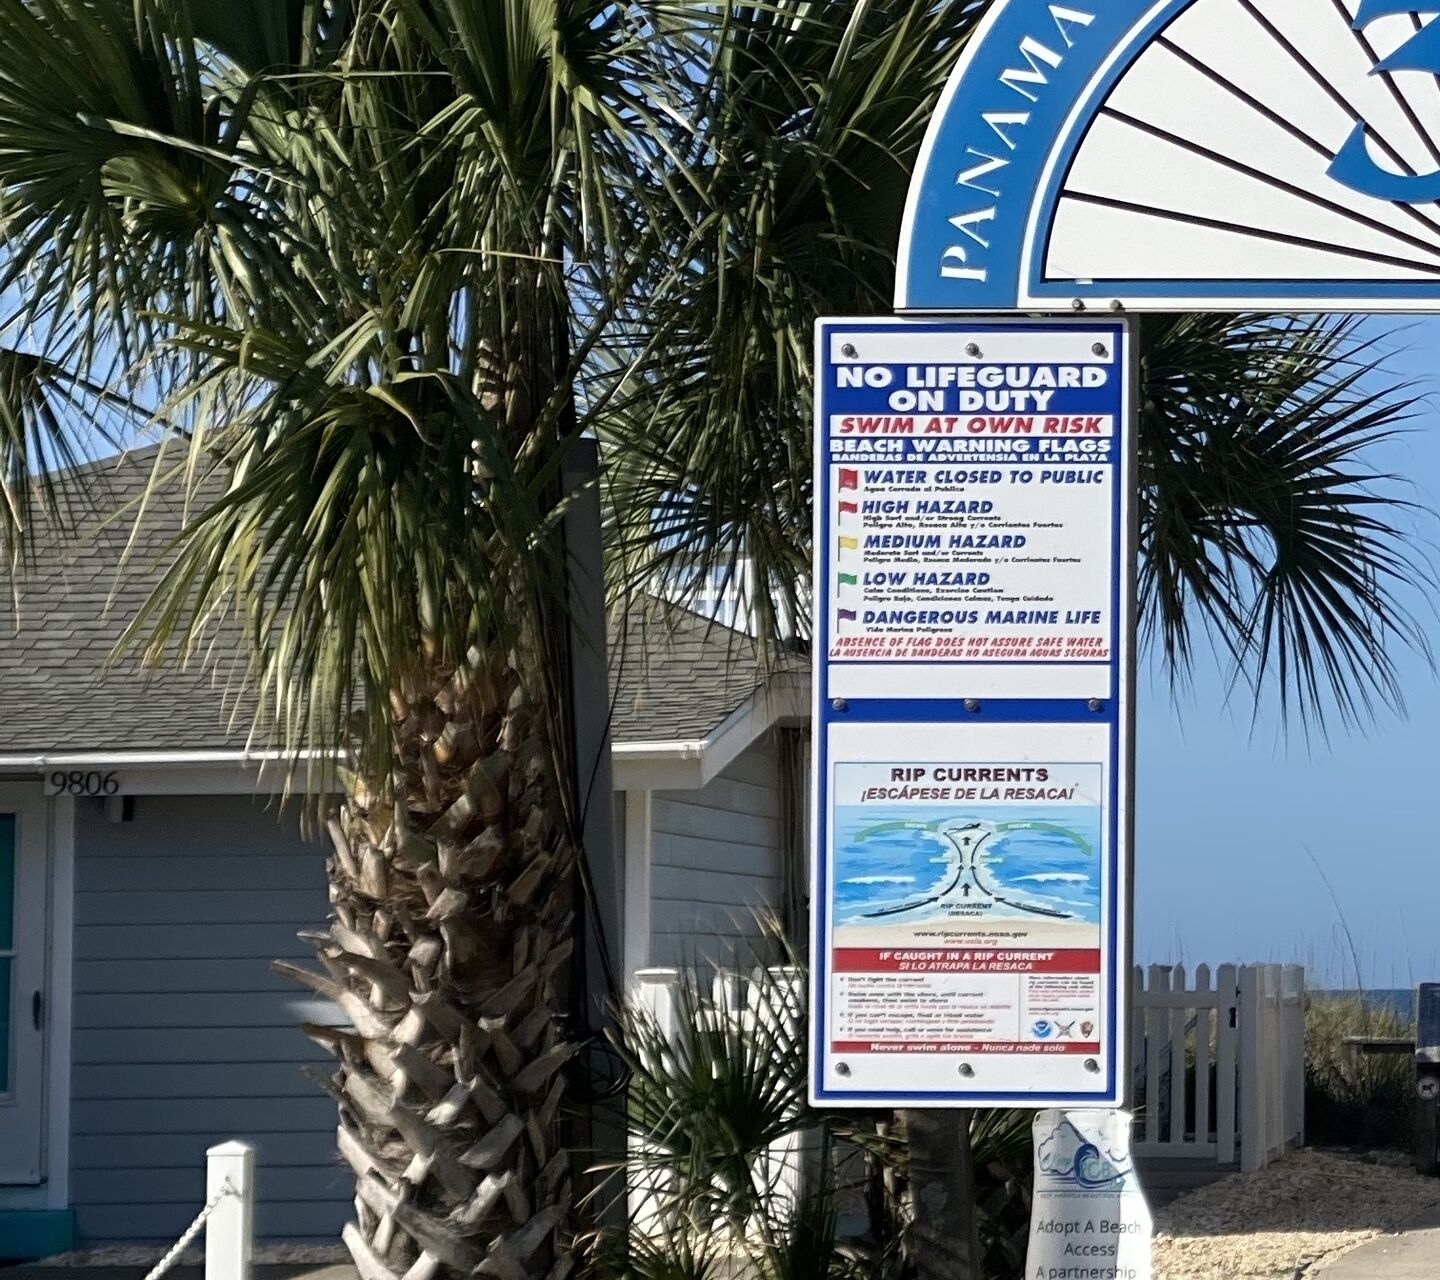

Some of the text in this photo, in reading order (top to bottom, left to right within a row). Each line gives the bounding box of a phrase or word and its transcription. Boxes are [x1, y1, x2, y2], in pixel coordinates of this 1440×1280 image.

[941, 3, 1096, 284] PANAMA
[837, 366, 1107, 388] NO LIFEGUARD
[888, 390, 1055, 412] ON DUTY
[839, 417, 1104, 434] SWIM AT OWN RISK
[829, 439, 1111, 453] BEACH WARNING FLAGS
[832, 453, 1108, 462] BANDERAS DE ADVERTENSIA EN LA PLAYA
[864, 470, 1104, 484] WATER CLOSED TO PUBLIC
[861, 500, 993, 514] HIGH HAZARD
[863, 534, 1026, 549] MEDIUM HAZARD
[863, 572, 990, 586] LOW HAZARD
[862, 610, 1101, 624] DANGEROUS MARINE LIFE
[836, 637, 1103, 647] ABSENCE OF FLAG DOES NOT ASSURE SAFE WATER
[830, 648, 1108, 657] LA AUSENCIA DE BANDERAS NO ASEGURA AGUAS SEGURAS
[891, 768, 1049, 782] RIP CURRENTS
[50, 771, 119, 796] 9806
[954, 788, 977, 800] DE
[979, 788, 1000, 800] LA
[879, 952, 1053, 961] IF CAUGHT IN A RIP CURRENT
[898, 962, 1033, 971] SI LO ATRAPA LA RESACA
[870, 1043, 904, 1052] Never
[907, 1043, 937, 1052] swim
[940, 1043, 971, 1052] alone
[981, 1043, 1013, 1052] Nunca
[1016, 1044, 1041, 1052] nade
[1043, 1044, 1066, 1052] solo
[1036, 1220, 1142, 1237] Adopt A Beach
[1063, 1243, 1116, 1257] Access
[1035, 1267, 1046, 1280] A
